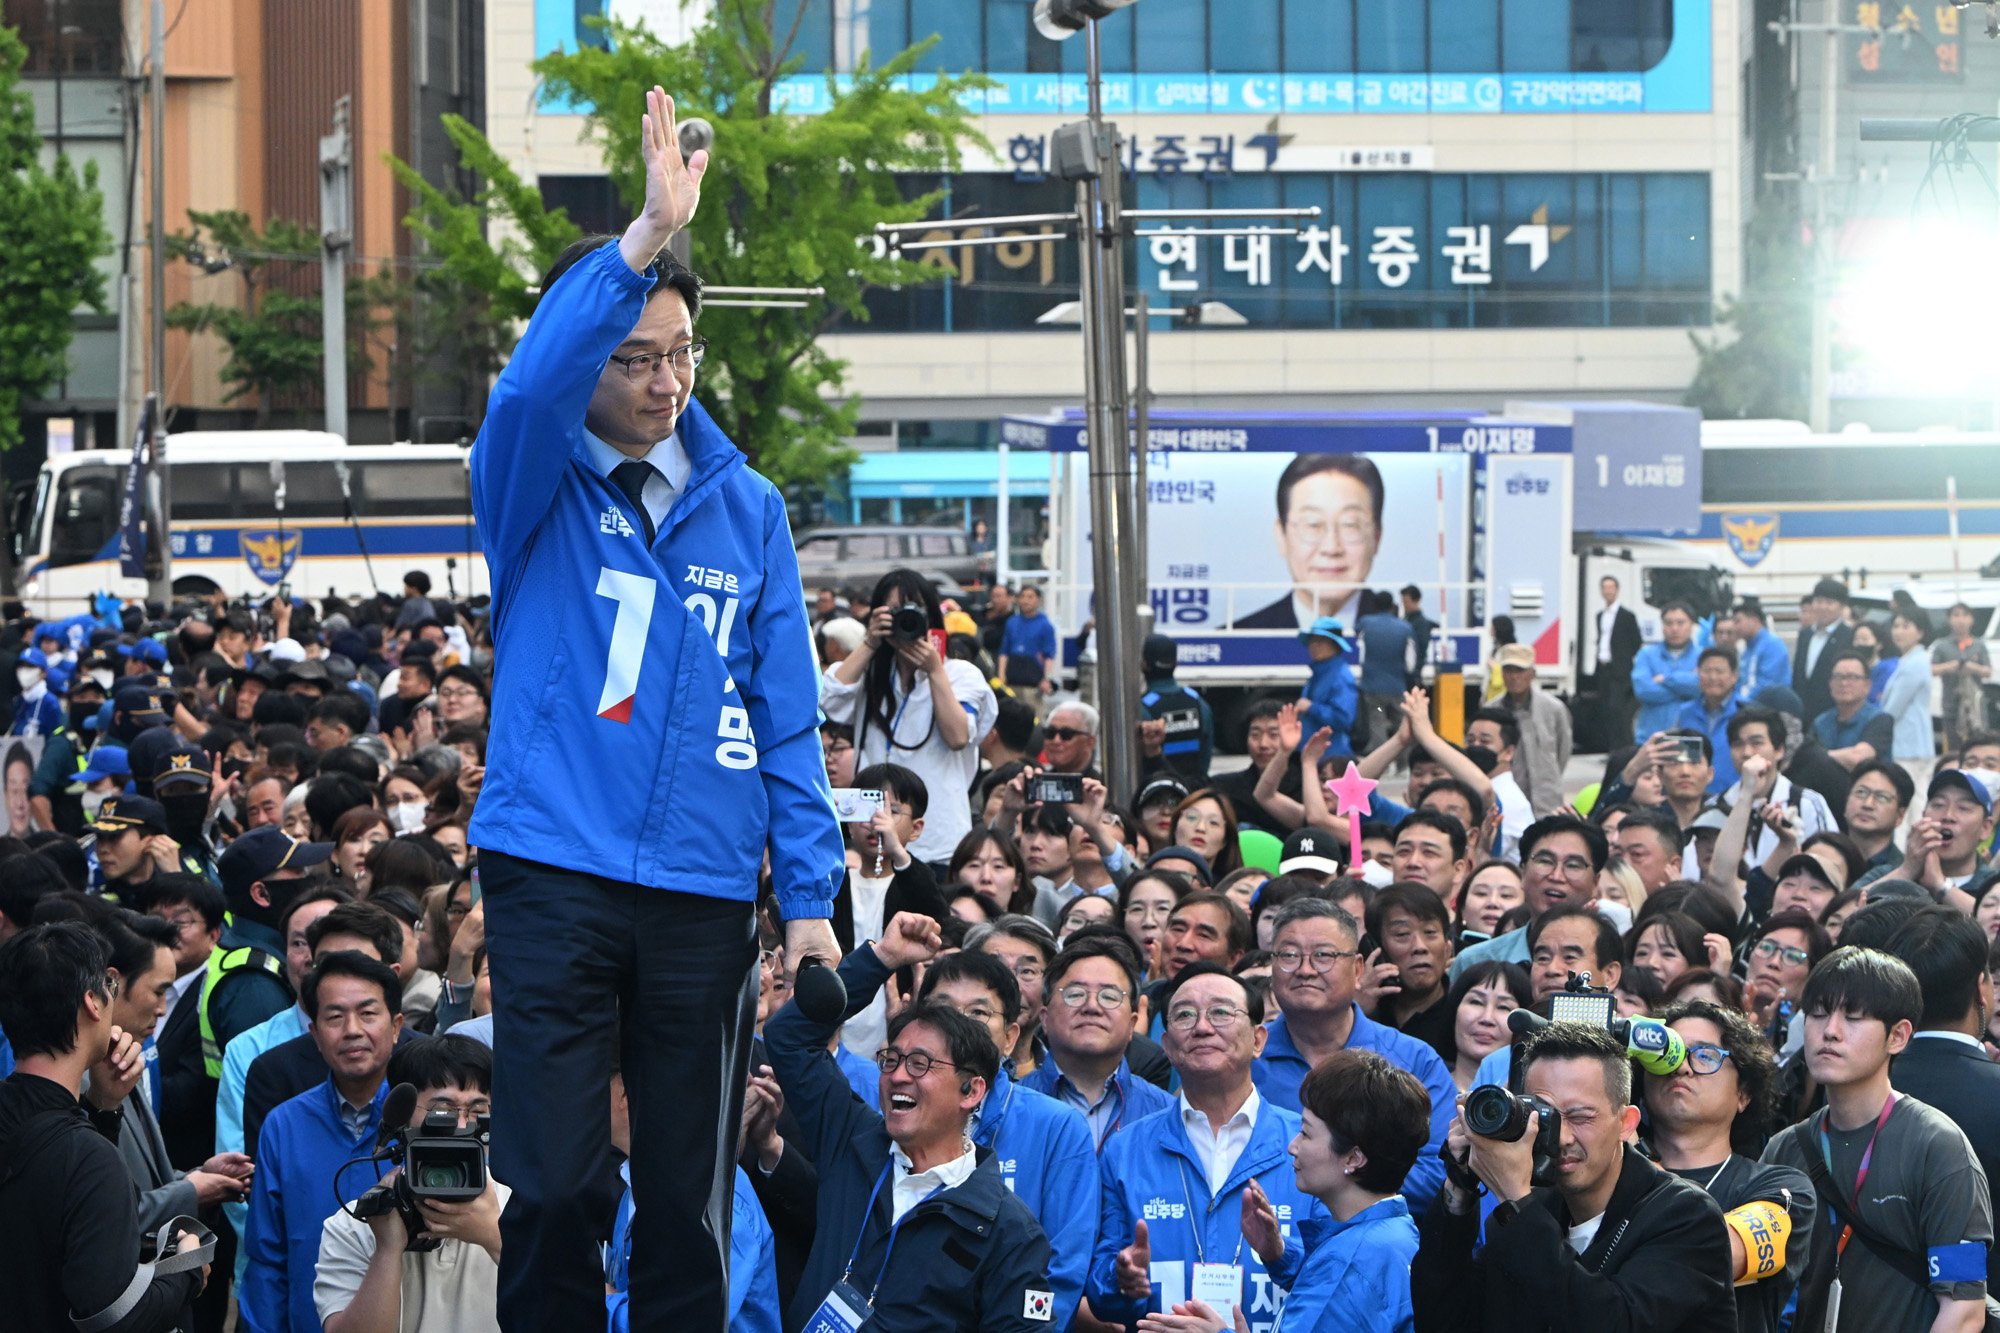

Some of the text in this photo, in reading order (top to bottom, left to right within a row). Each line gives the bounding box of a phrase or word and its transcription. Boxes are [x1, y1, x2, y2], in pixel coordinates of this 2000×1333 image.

[1149, 224, 1493, 291] 현대차증권
[1181, 429, 1248, 451] 대한민국
[1425, 427, 1536, 454] 1 이재명
[1595, 454, 1685, 488] 1 이재명
[684, 564, 739, 594] 지금은
[595, 566, 657, 725] 1
[1143, 1203, 1186, 1220] 민주당
[1731, 1209, 1775, 1274] PRESS
